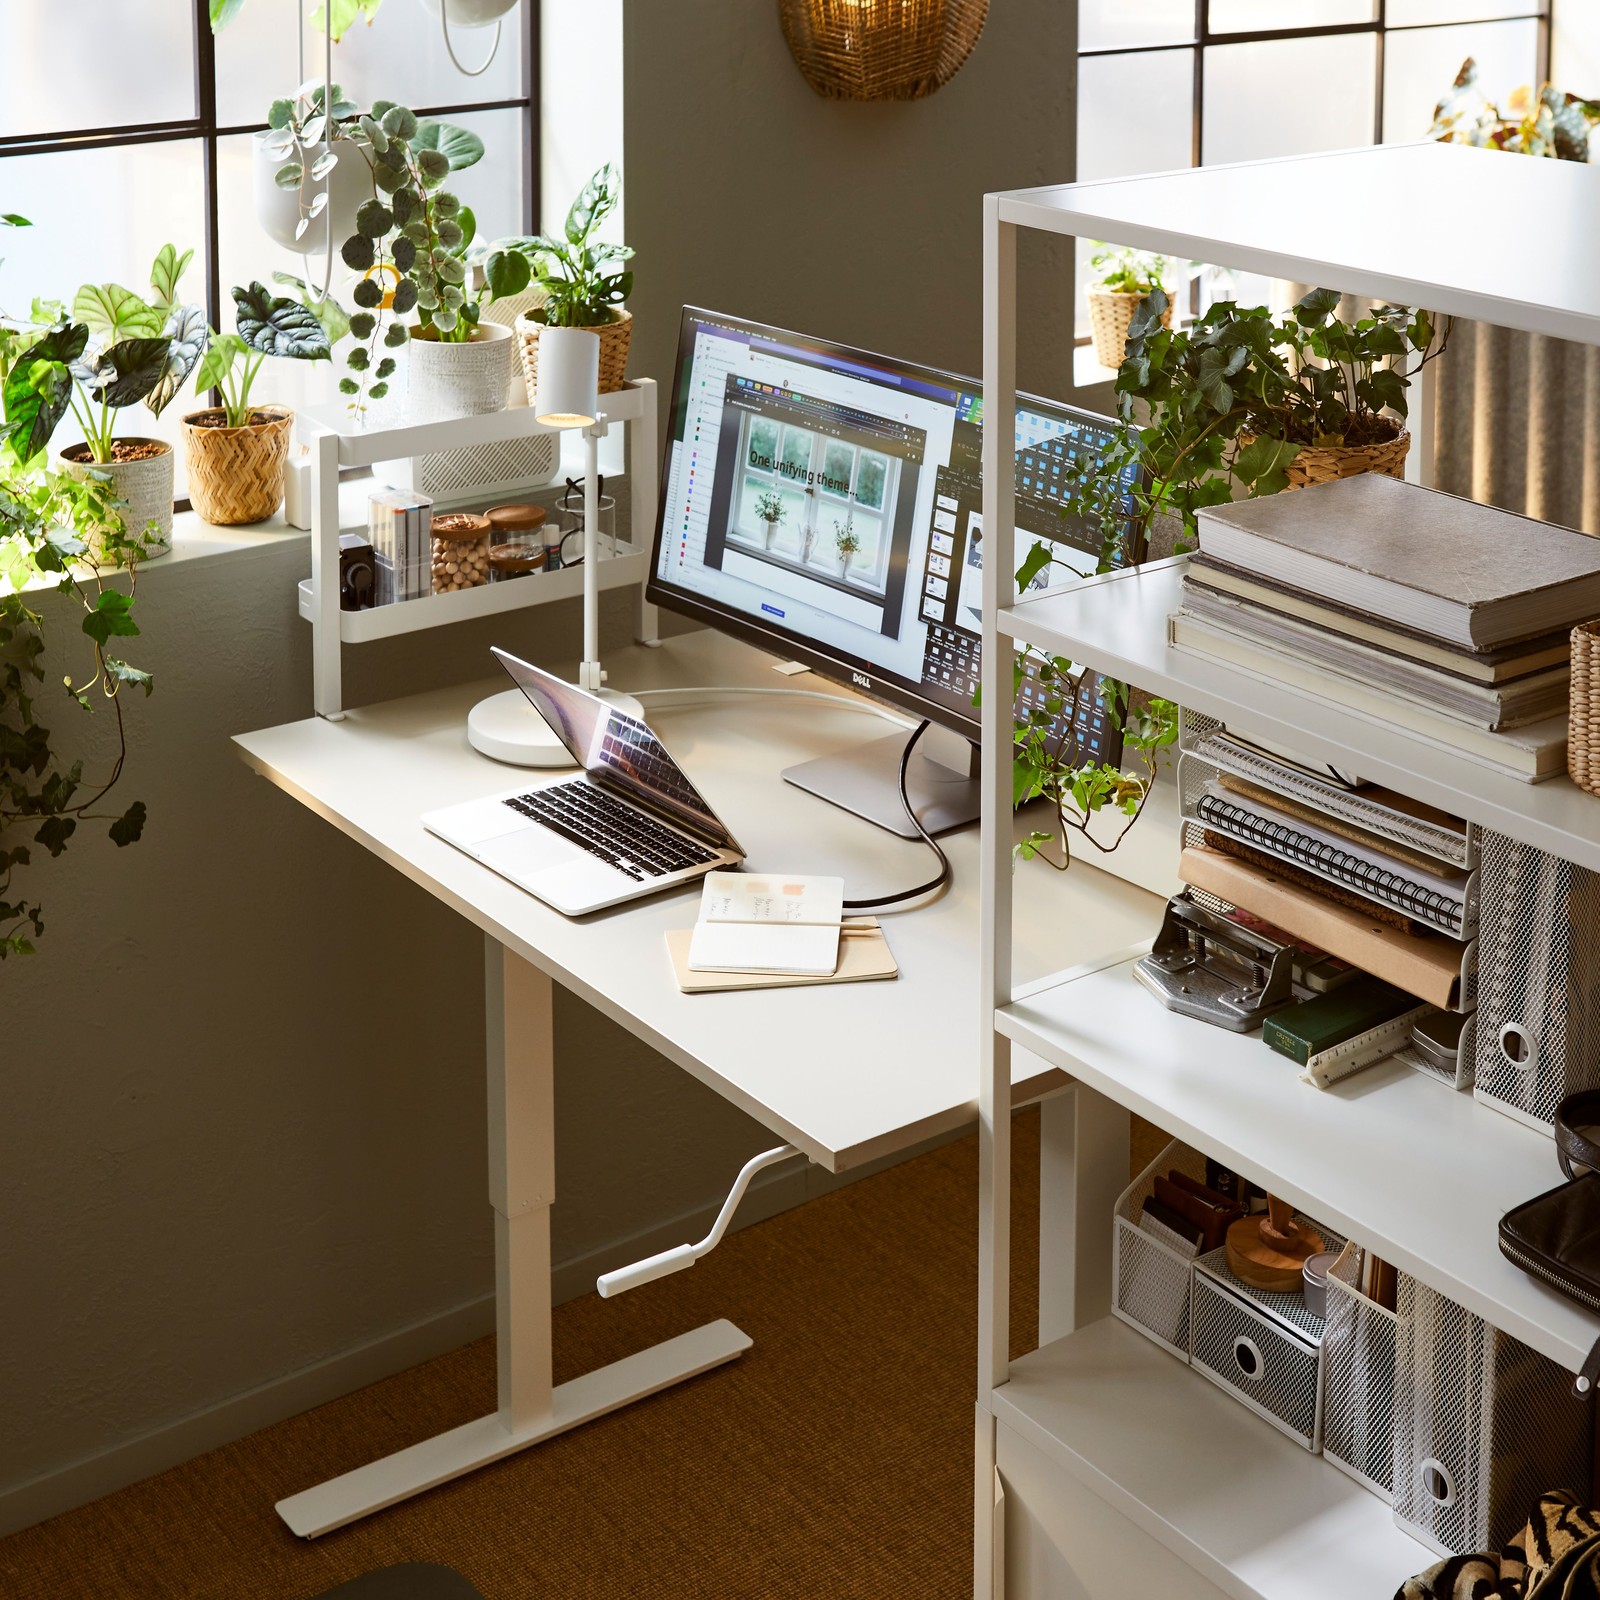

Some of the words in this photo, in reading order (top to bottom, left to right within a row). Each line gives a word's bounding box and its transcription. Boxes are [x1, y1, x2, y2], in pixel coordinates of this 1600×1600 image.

[750, 450, 770, 467] One
[772, 459, 814, 485] unifying
[817, 472, 858, 497] theme...
[852, 672, 871, 689] DELL
